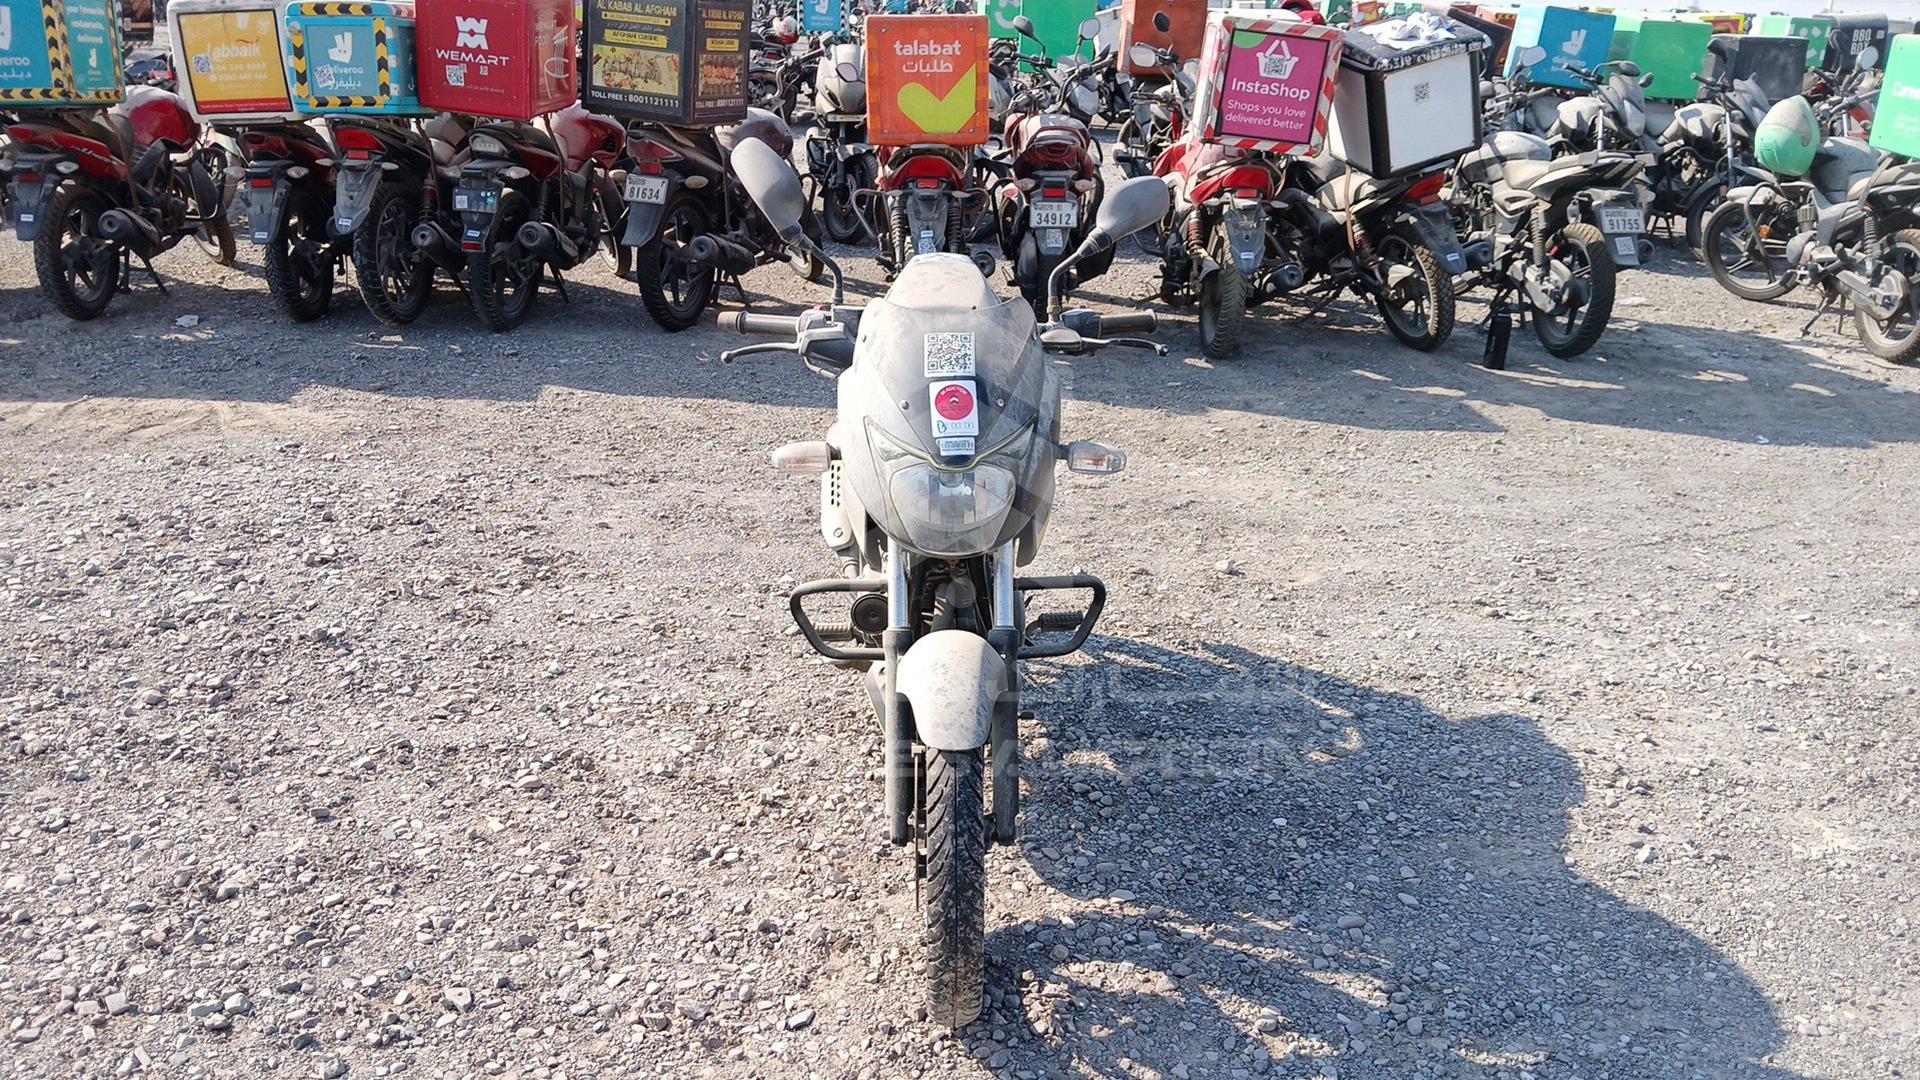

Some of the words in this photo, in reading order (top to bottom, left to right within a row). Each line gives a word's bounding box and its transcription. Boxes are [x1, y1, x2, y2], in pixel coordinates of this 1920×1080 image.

[633, 3, 644, 13] AL
[1852, 29, 1871, 42] BBQ
[893, 40, 961, 55] talabat
[436, 48, 510, 66] WEMART
[902, 59, 954, 77] طلبات
[1231, 78, 1310, 101] InstaShop
[590, 90, 607, 99] TOLL
[607, 92, 623, 101] FREE
[628, 93, 679, 108] 8001121111
[1227, 99, 1260, 112] Shops
[1262, 105, 1281, 115] you
[1284, 107, 1306, 118] love
[1225, 112, 1271, 126] delivered
[1273, 118, 1304, 130] better
[629, 186, 660, 200] 81634
[1036, 212, 1071, 225] 34912
[1608, 219, 1640, 230] 91755
